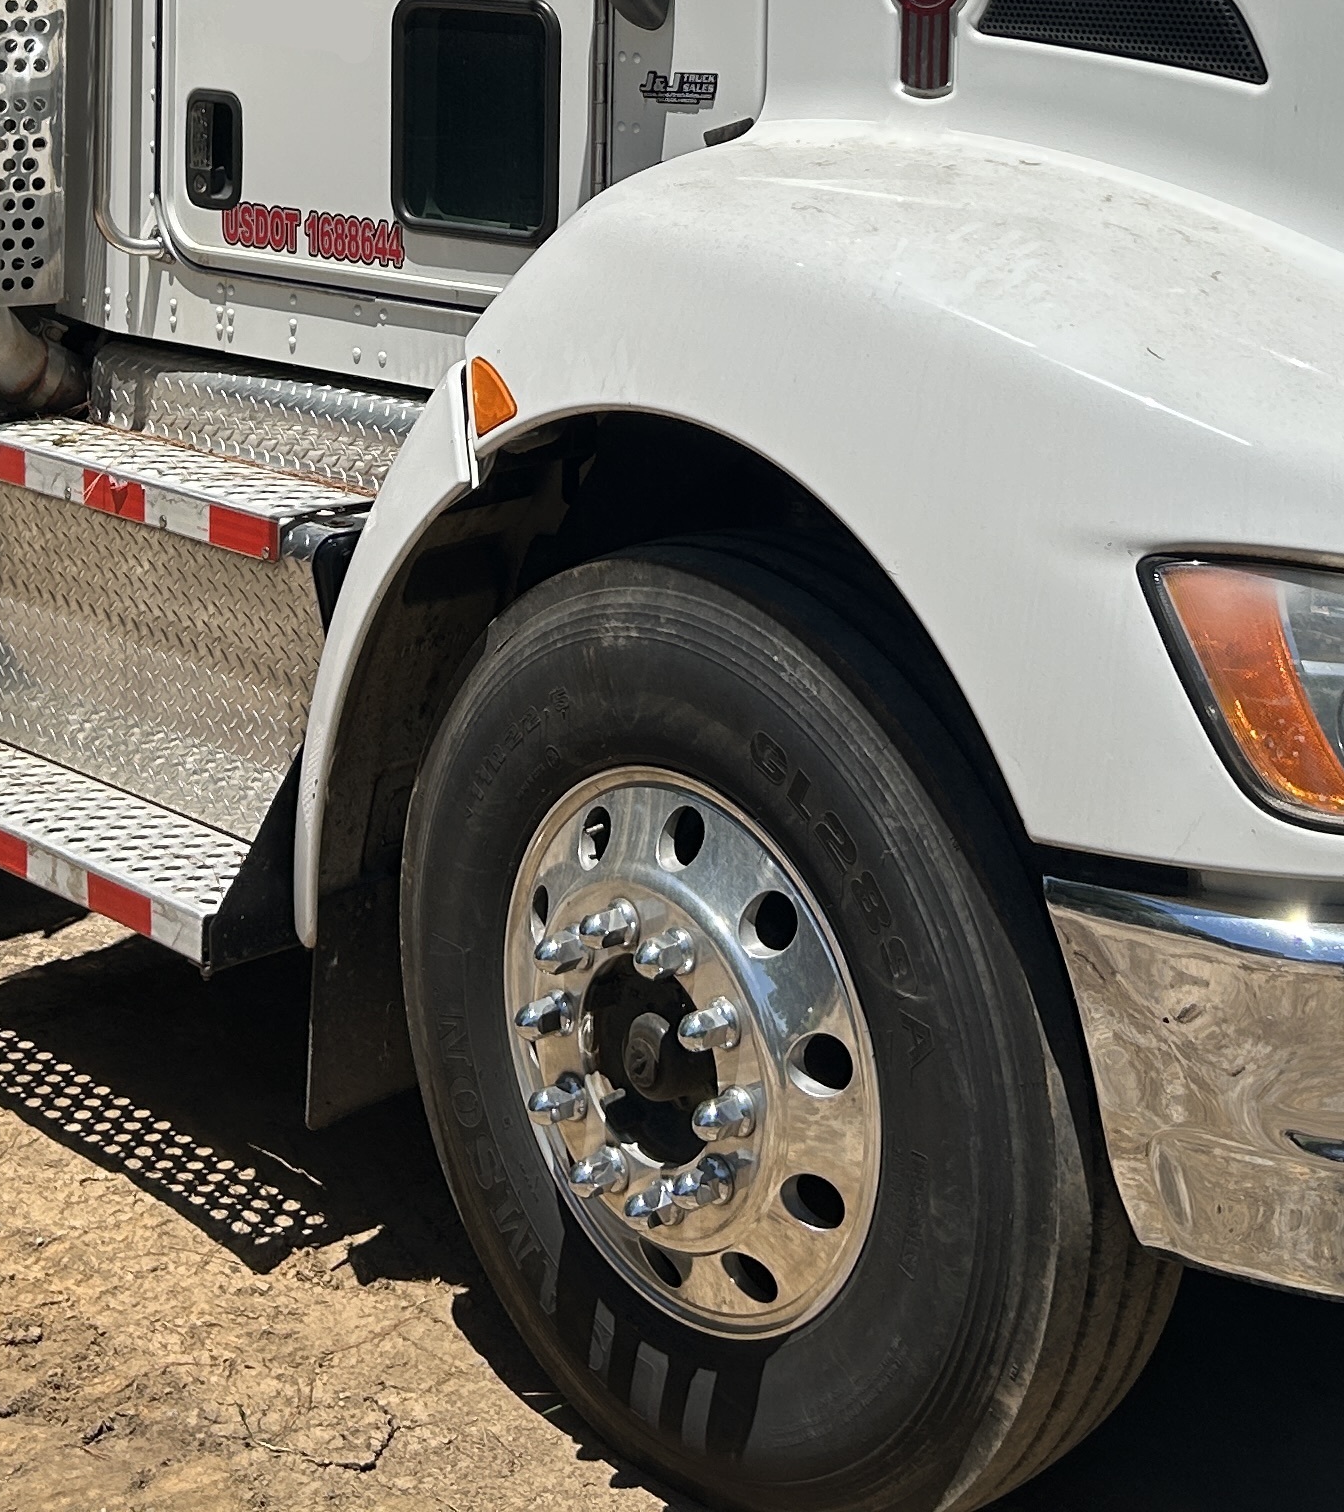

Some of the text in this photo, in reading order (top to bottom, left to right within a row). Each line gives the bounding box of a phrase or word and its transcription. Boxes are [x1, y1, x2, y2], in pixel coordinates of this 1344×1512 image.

[682, 73, 717, 83] TRUCK
[682, 83, 715, 93] SALES
[222, 201, 404, 269] USDOT 1688644
